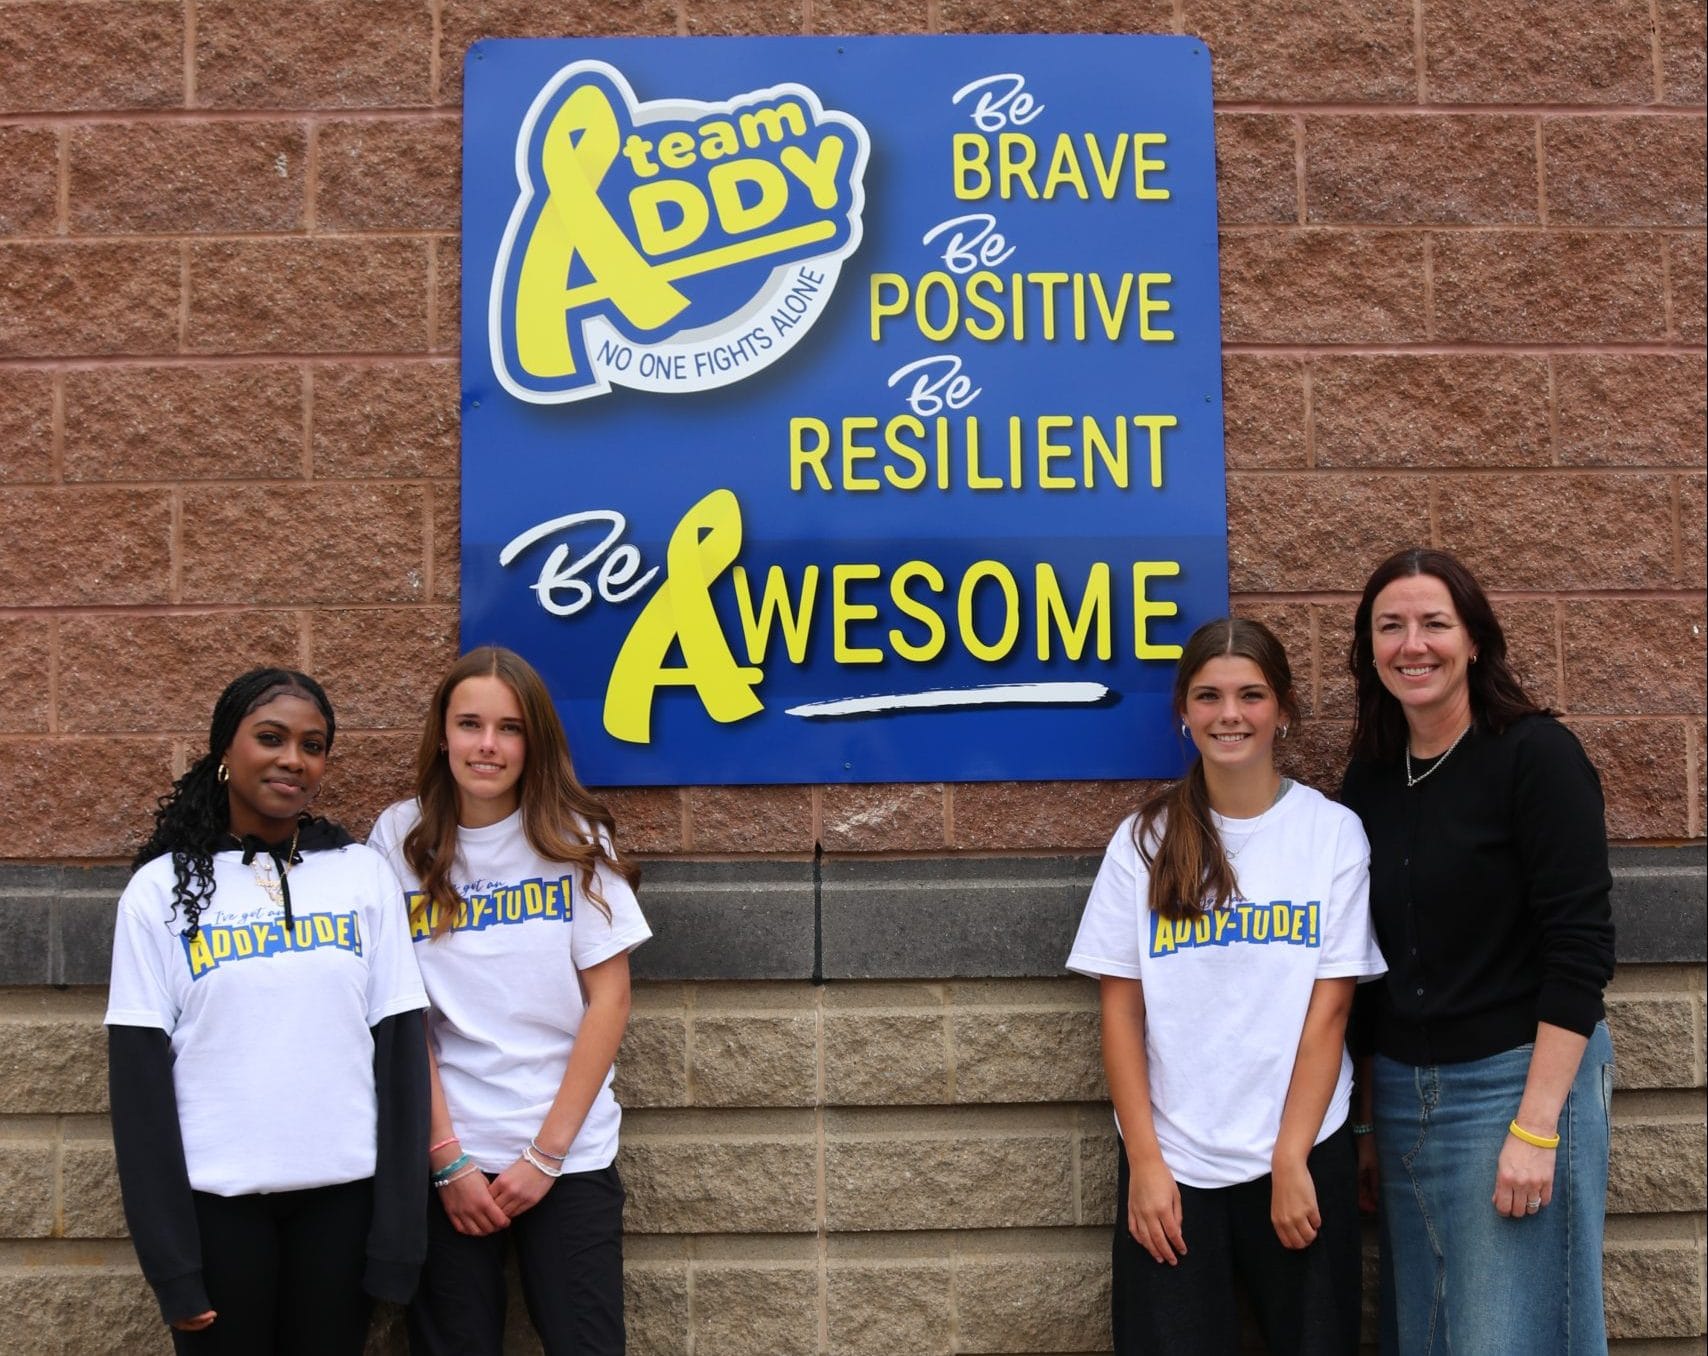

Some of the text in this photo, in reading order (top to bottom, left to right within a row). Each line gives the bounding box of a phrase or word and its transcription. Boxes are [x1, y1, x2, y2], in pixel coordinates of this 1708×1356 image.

[952, 73, 1045, 132] Be
[622, 102, 807, 178] team
[953, 133, 1170, 199] BRAVE
[923, 213, 1016, 274] Be
[597, 266, 825, 380] NO ONE FIGHTS ALONE
[870, 271, 1175, 341] POSITIVE
[888, 354, 982, 416] Be
[790, 414, 1177, 490] RESILIENT
[499, 489, 1184, 744] Be AWESOME
[463, 879, 486, 896] got
[188, 912, 361, 976] ADDY-TUDE!
